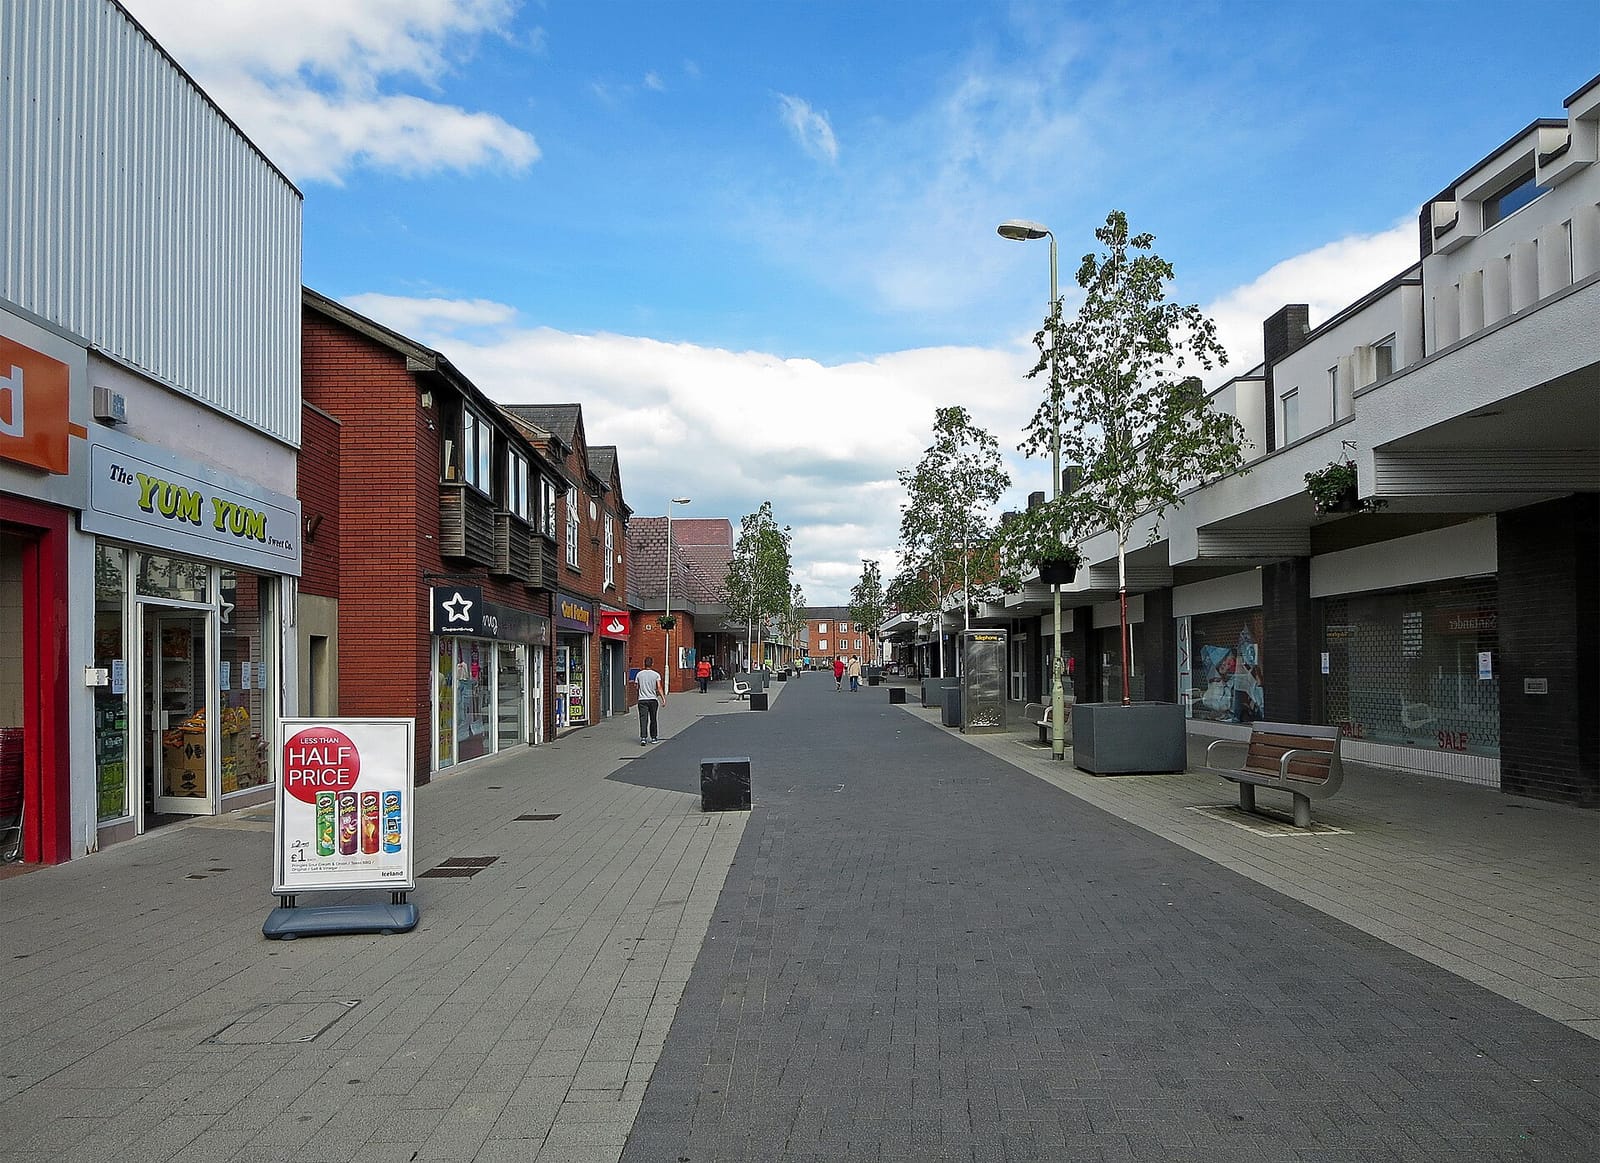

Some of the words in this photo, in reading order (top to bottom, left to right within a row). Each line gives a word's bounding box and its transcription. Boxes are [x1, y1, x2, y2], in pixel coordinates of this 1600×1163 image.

[110, 463, 134, 485] The
[136, 472, 203, 526] YUM
[211, 497, 267, 543] YUM
[267, 535, 284, 549] Sweet
[284, 541, 293, 551] Co.
[300, 737, 318, 745] LESS
[1438, 731, 1469, 751] SALE
[289, 746, 352, 767] HALF
[289, 768, 351, 787] PRICE
[291, 849, 306, 862] £1
